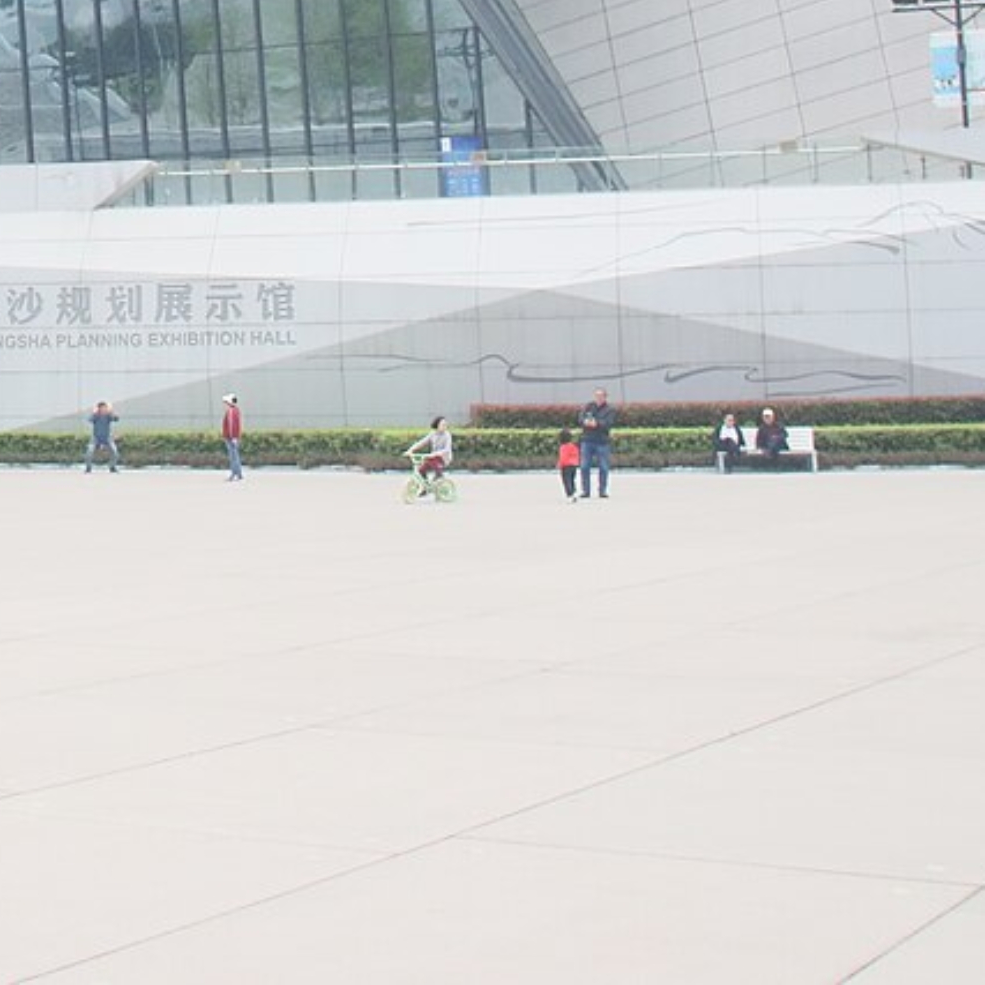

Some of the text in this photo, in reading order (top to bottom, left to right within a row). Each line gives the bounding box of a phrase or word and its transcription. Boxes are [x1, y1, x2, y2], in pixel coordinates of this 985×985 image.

[56, 332, 143, 349] PLANNING
[149, 330, 245, 348] EXHIBITION
[251, 329, 297, 346] HALL
